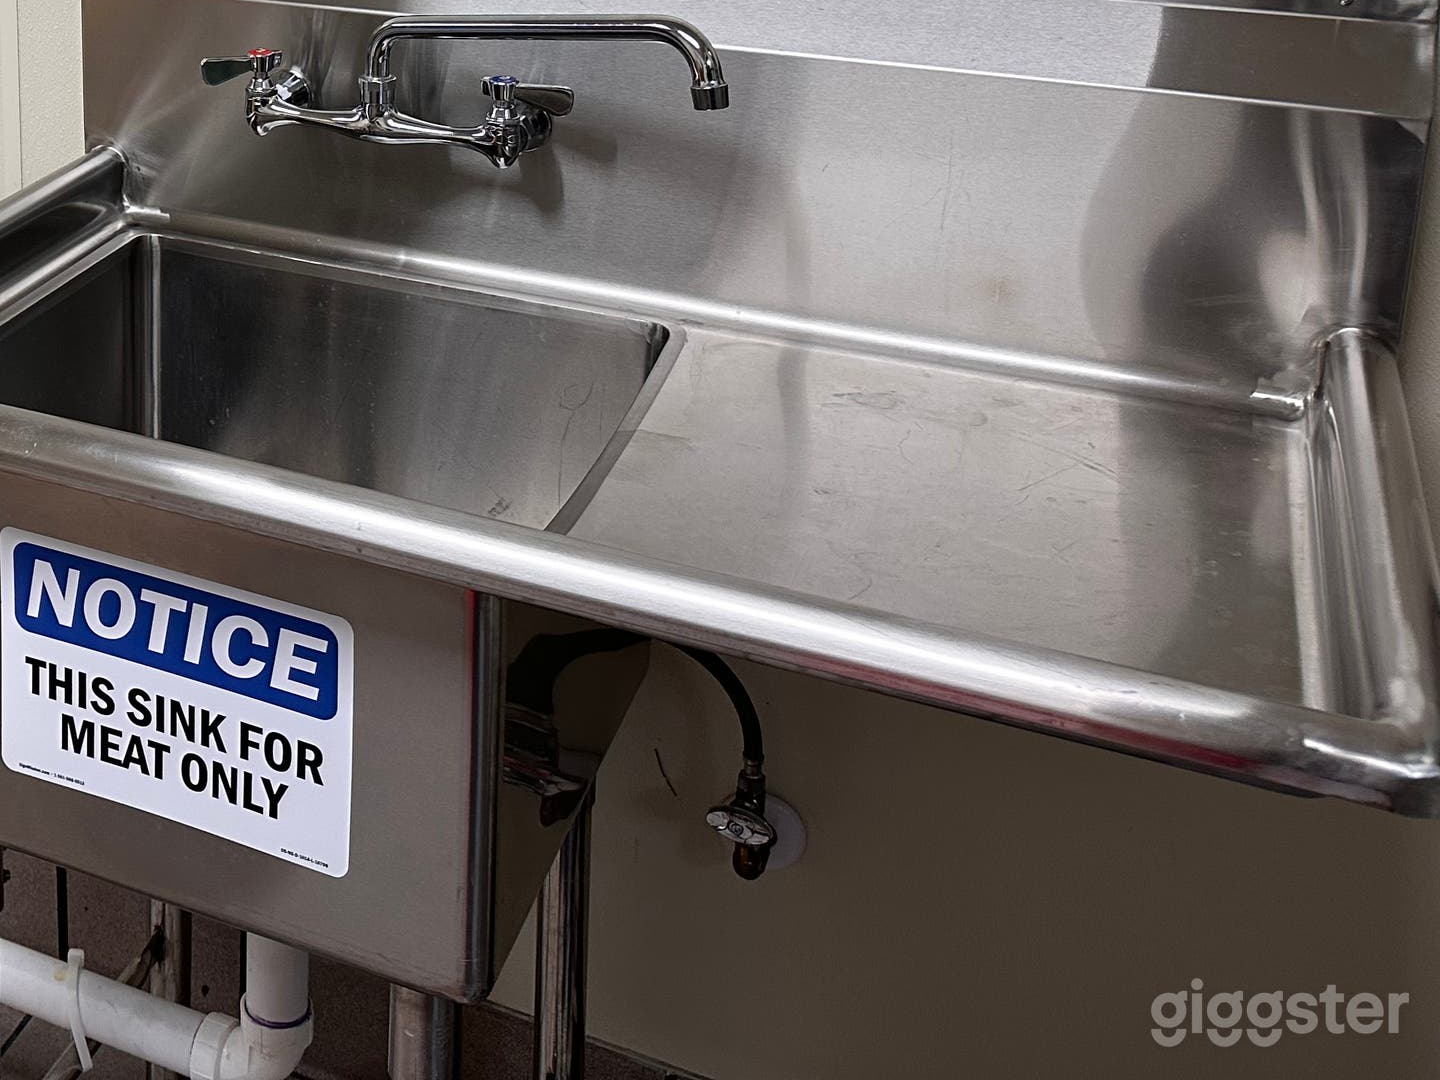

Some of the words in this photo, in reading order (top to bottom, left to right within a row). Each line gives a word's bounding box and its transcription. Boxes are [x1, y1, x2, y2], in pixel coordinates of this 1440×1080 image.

[26, 558, 329, 701] NOTICE
[25, 655, 115, 716] THIS
[126, 687, 227, 754] SINK
[239, 721, 324, 786] FOR
[60, 713, 171, 780] MEAT
[180, 752, 289, 820] ONLY
